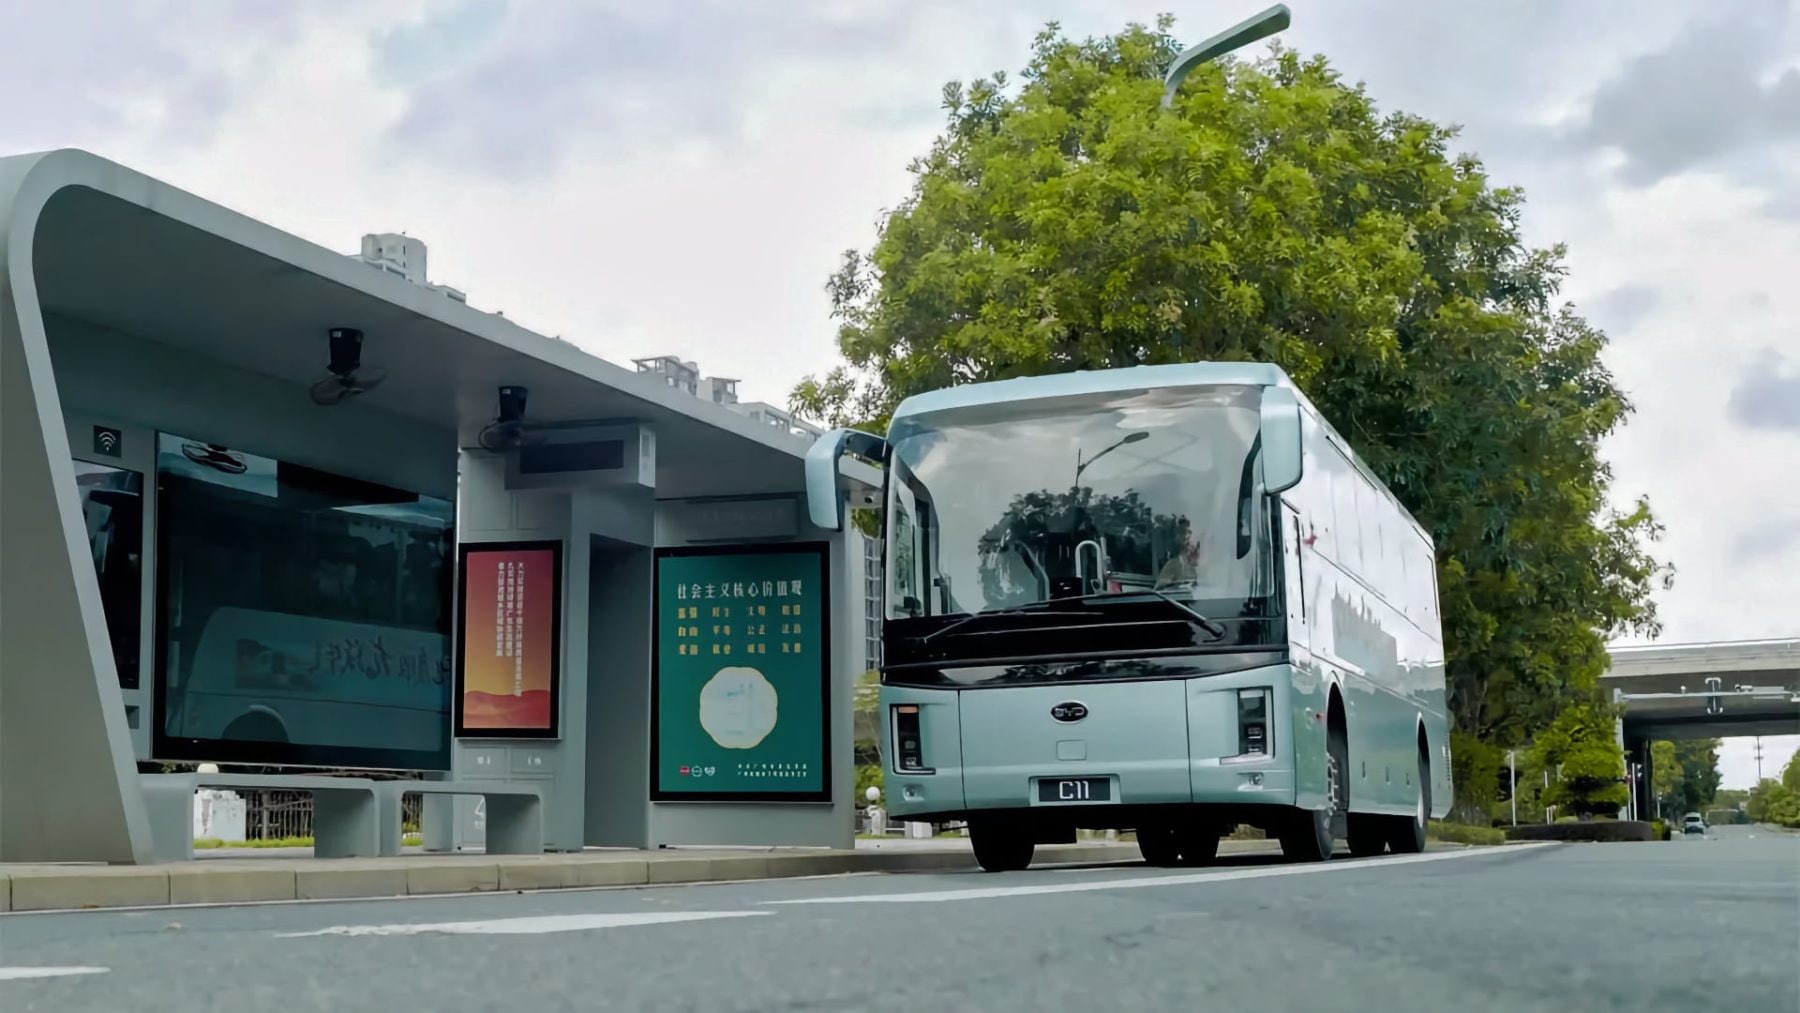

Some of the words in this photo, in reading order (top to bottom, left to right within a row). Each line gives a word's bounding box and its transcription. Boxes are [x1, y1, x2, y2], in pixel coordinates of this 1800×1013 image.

[678, 580, 802, 599] 社会主义核心价值观
[1059, 780, 1089, 800] C11
